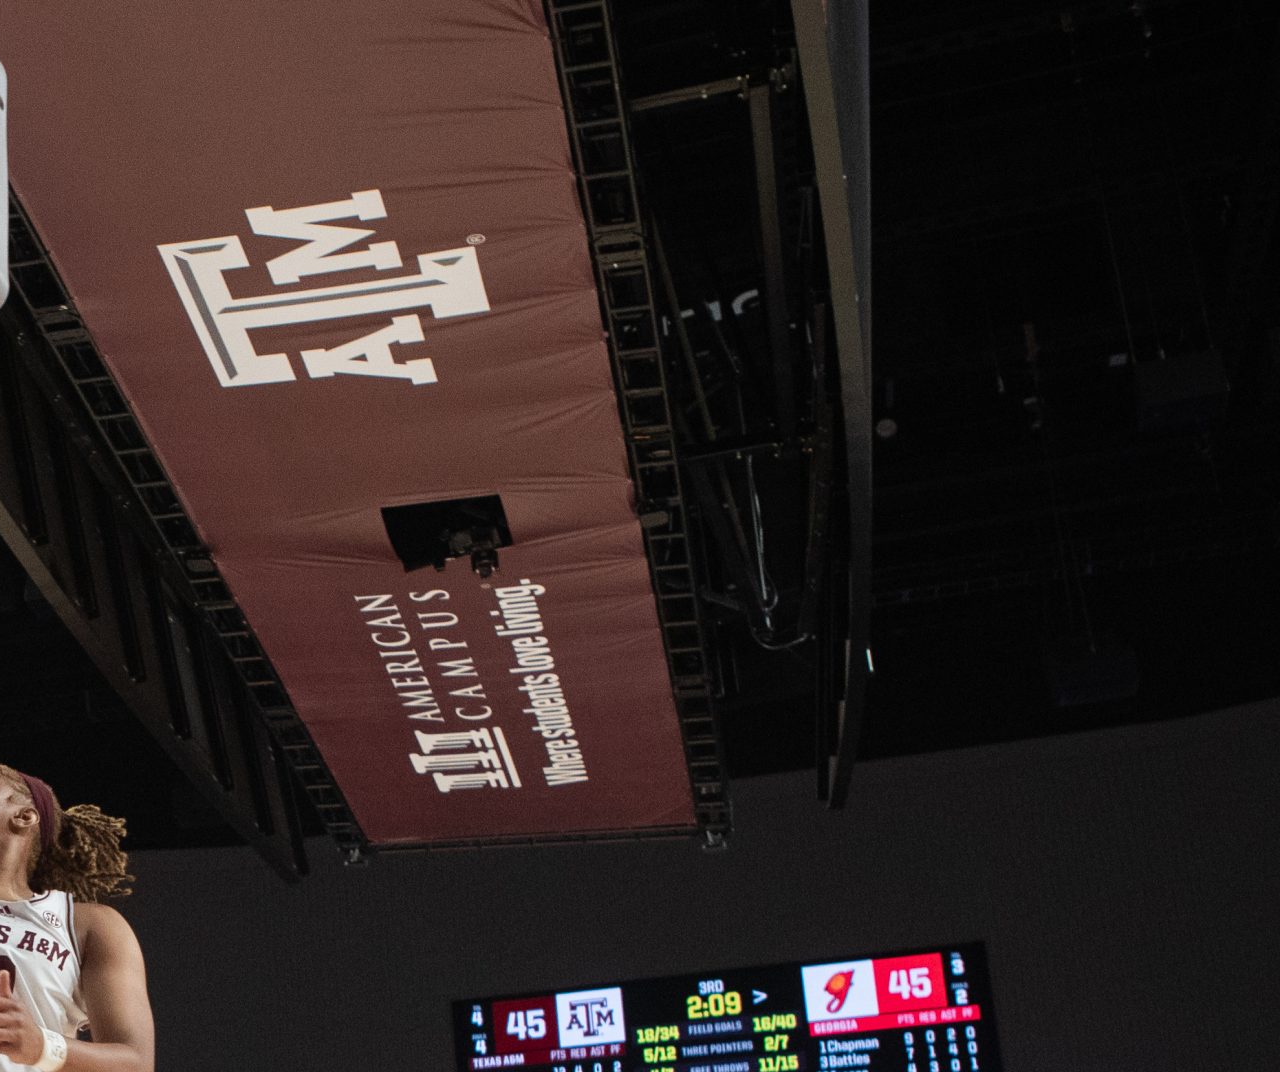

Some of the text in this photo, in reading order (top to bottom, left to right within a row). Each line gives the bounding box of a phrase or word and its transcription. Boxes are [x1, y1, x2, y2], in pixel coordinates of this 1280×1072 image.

[354, 594, 445, 722] AMERICAN
[409, 589, 493, 721] CAMPUS
[490, 578, 589, 786] Where students love living.
[43, 911, 62, 928] SEC
[17, 930, 71, 971] A&M
[951, 958, 964, 975] 3
[698, 979, 724, 995] 3RD
[888, 967, 932, 1000] 45
[686, 991, 742, 1019] 2:09
[956, 989, 968, 1005] 2
[472, 1011, 483, 1026] 4
[506, 1008, 546, 1040] 45
[814, 1019, 858, 1034] GEORGIA
[688, 1022, 713, 1036] FIELD
[715, 1020, 742, 1033] GOALS
[475, 1040, 487, 1054] 4
[644, 1034, 789, 1063] 5/12 THREE POINTERS 2/7
[827, 1038, 879, 1054] Chapman
[473, 1055, 501, 1069] TEXAS
[550, 1049, 566, 1061] PTS
[758, 1054, 799, 1072] 11/15
[830, 1053, 870, 1068] Battles
[906, 1047, 914, 1060] 7
[929, 1045, 936, 1058] 1
[948, 1042, 958, 1056] 4
[971, 1056, 978, 1070] 1
